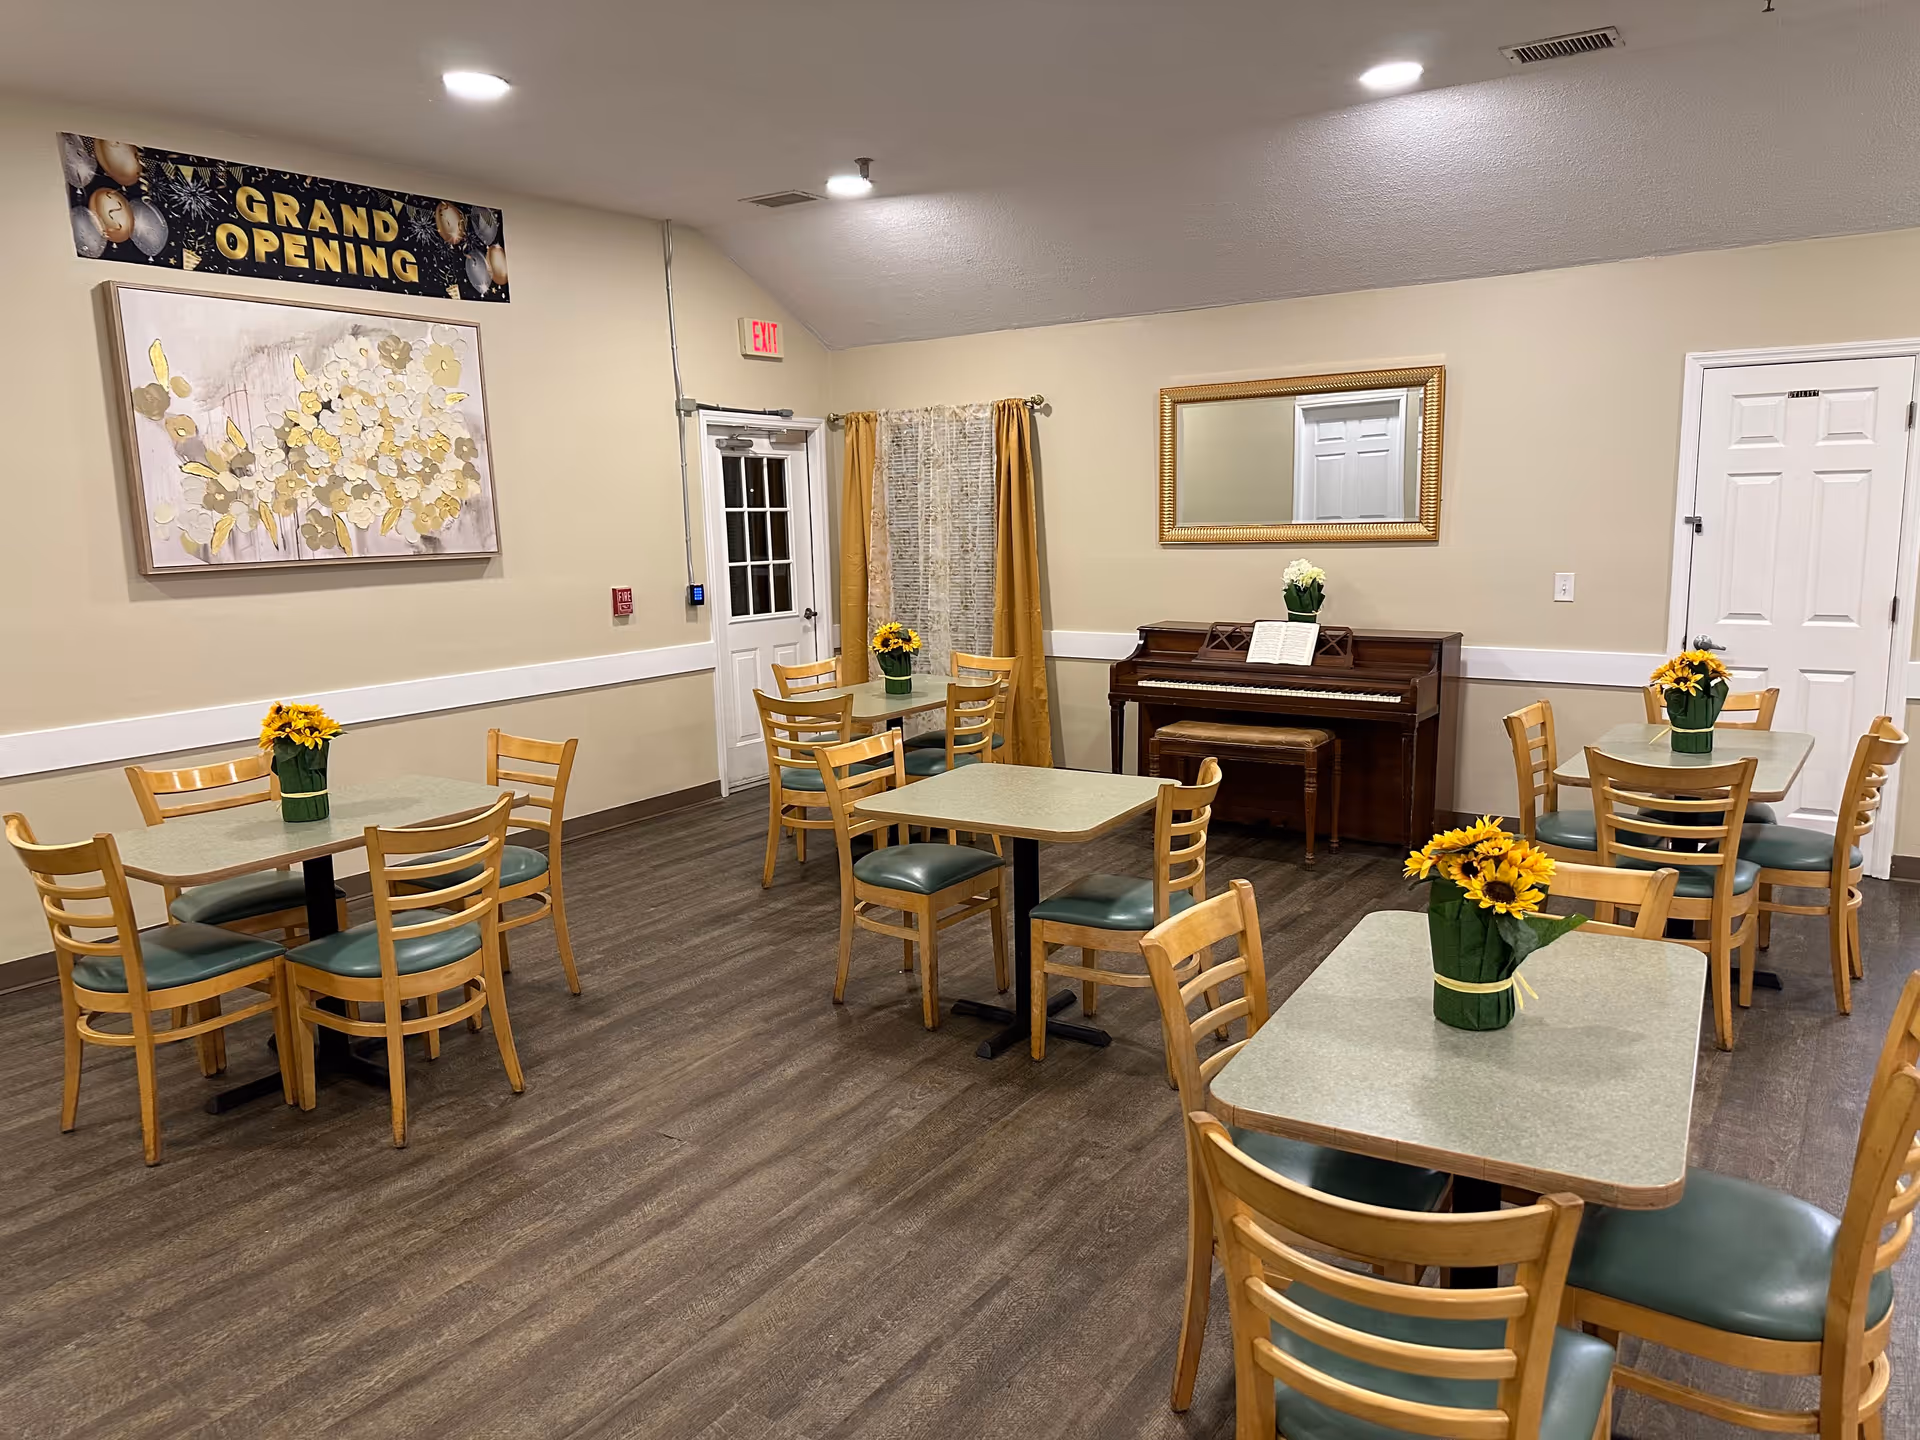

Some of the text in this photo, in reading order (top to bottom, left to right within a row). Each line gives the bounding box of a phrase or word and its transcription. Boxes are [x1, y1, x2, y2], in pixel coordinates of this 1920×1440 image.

[235, 186, 400, 243] GRAND
[215, 223, 420, 283] OPENING
[752, 320, 778, 354] EXIT
[1788, 389, 1819, 398] UTILITY
[618, 591, 631, 602] FIRE
